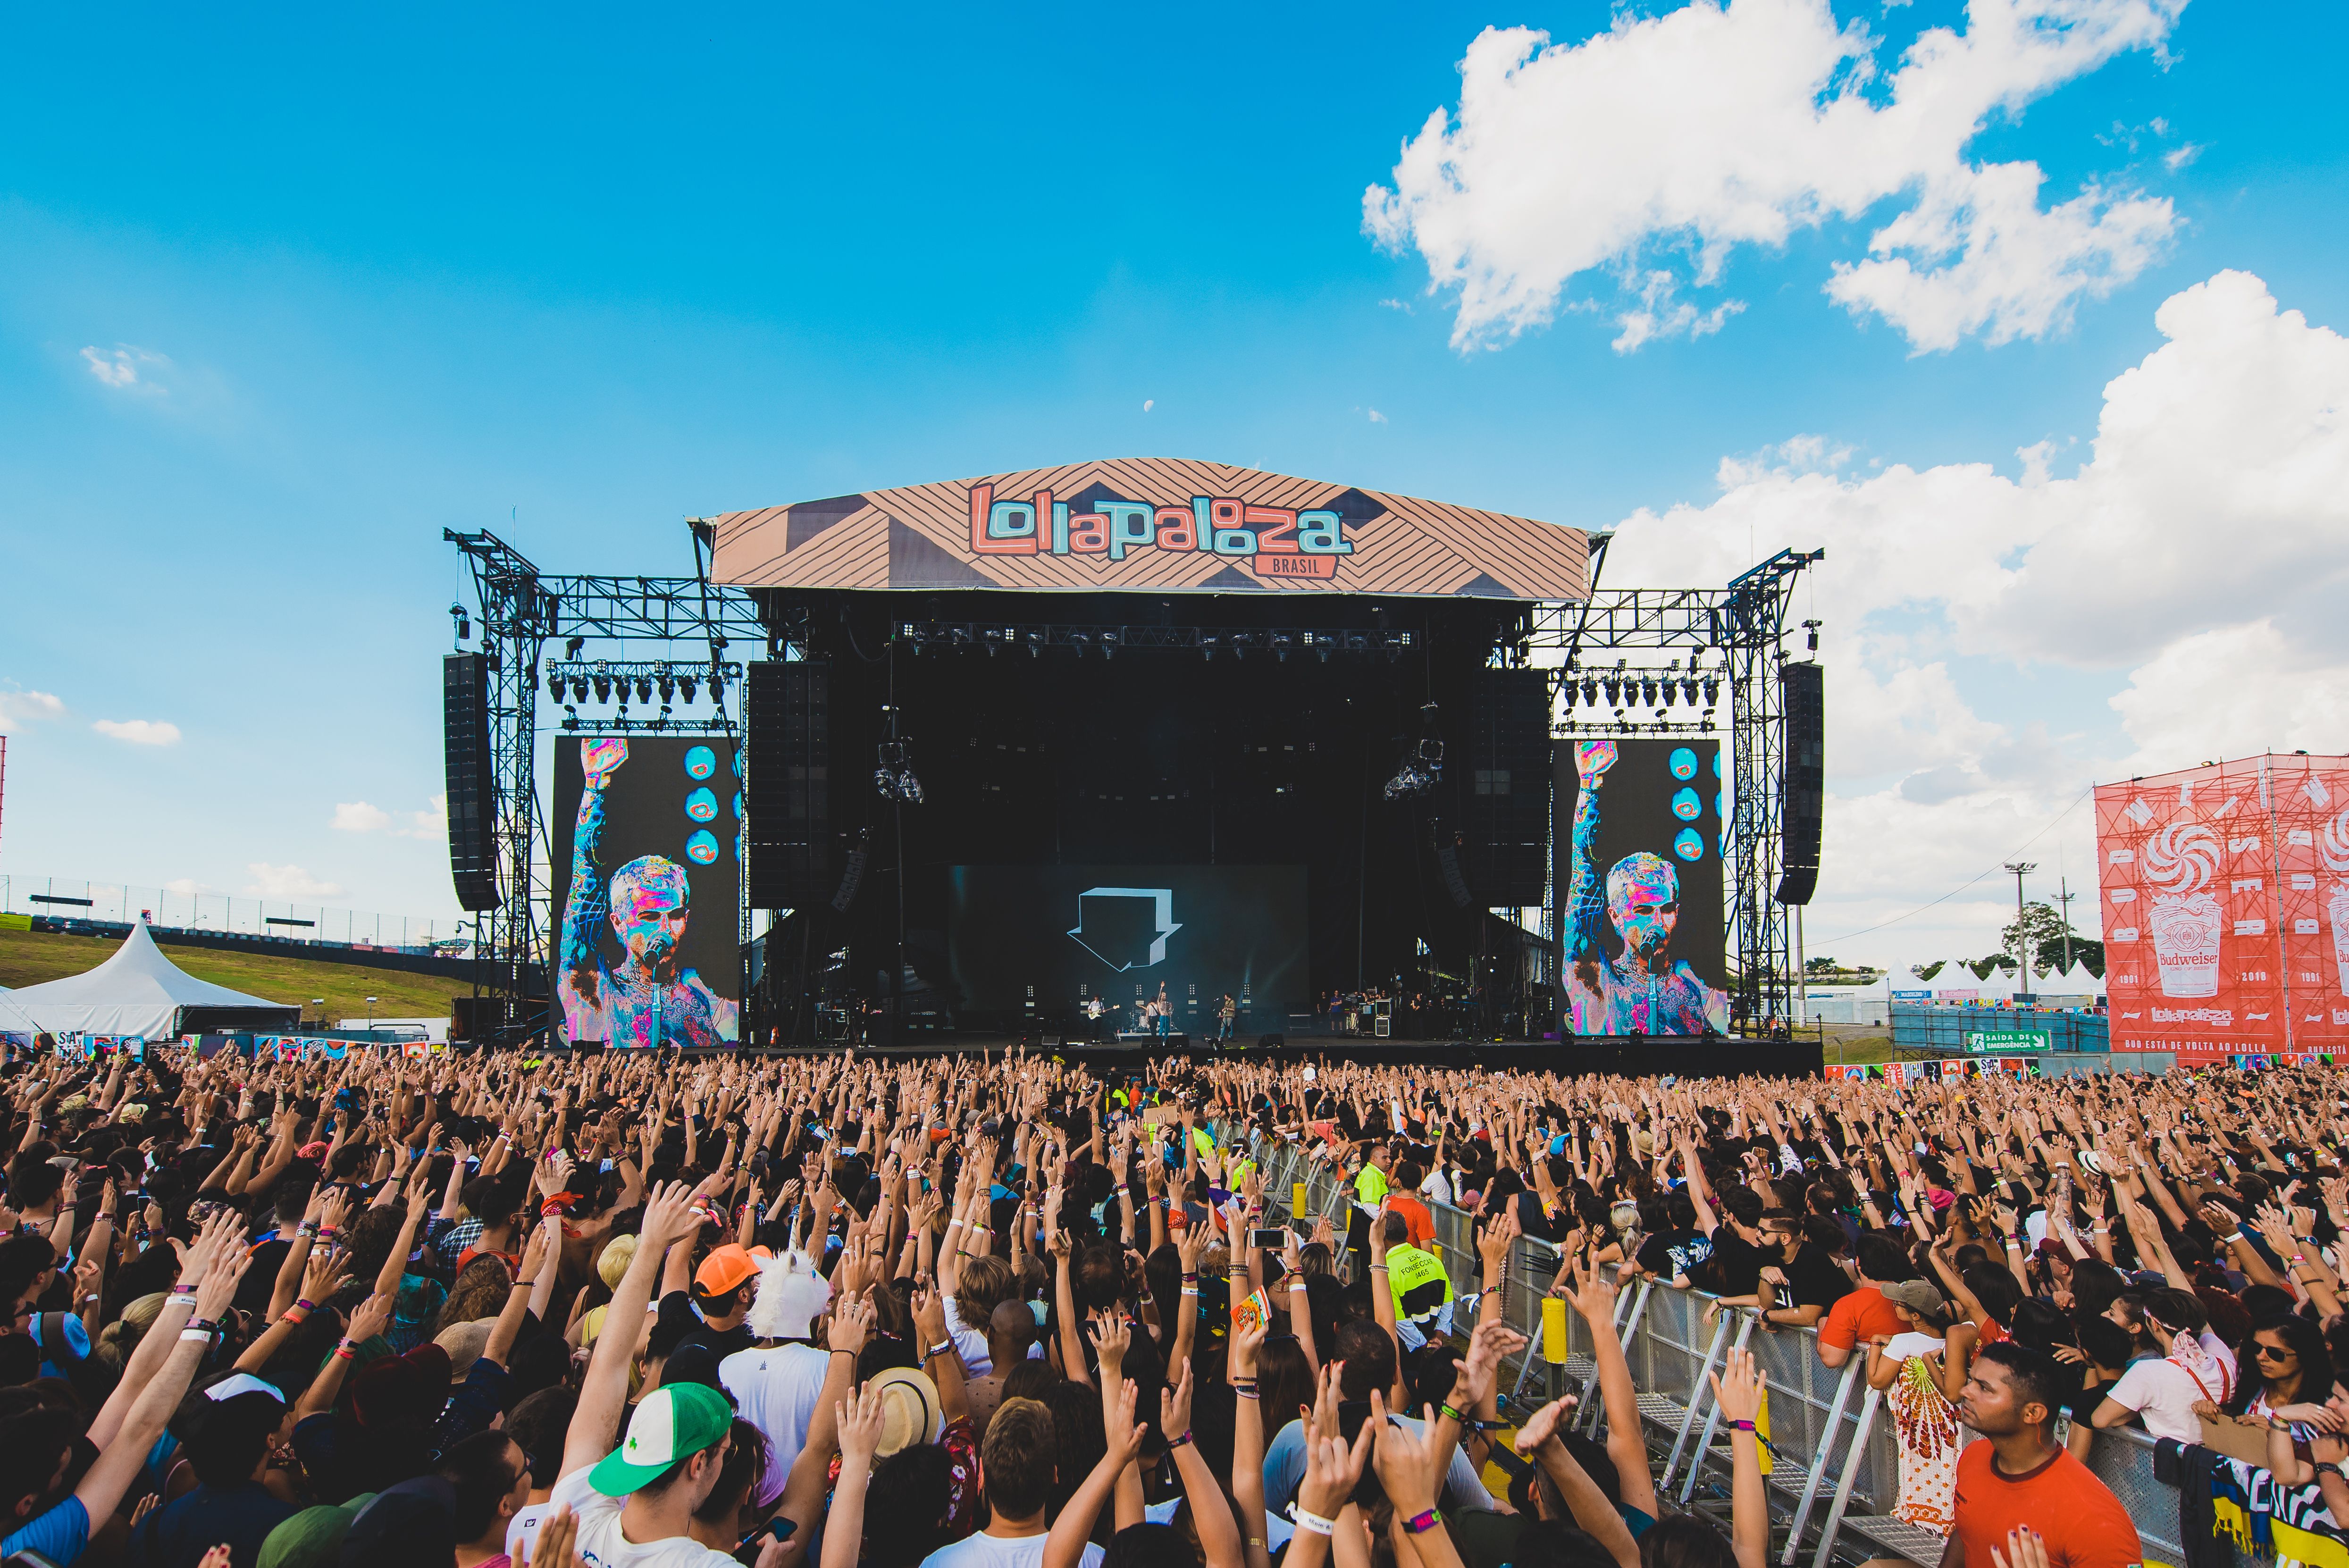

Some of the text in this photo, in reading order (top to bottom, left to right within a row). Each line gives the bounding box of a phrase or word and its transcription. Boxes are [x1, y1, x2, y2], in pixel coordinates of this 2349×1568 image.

[970, 483, 1354, 562] Lollapalooza
[1273, 557, 1320, 574] BRASIL
[2159, 951, 2217, 965] Budweiser
[2119, 974, 2139, 983] 1991
[2242, 971, 2267, 981] 2018
[2301, 972, 2320, 982] 1991
[2151, 1007, 2234, 1023] Lollapalooza
[1986, 1033, 2012, 1041] SAÍDA
[1987, 1040, 2031, 1049] EMERGÊNCIA
[2125, 1040, 2267, 1053] BUD ESTÁ DE VOLTA AO LOLLA
[2327, 1044, 2347, 1055] ESTÁ
[1408, 1253, 1420, 1262] ESC
[1401, 1258, 1433, 1275] FONSECCAS
[1415, 1268, 1429, 1279] 0465
